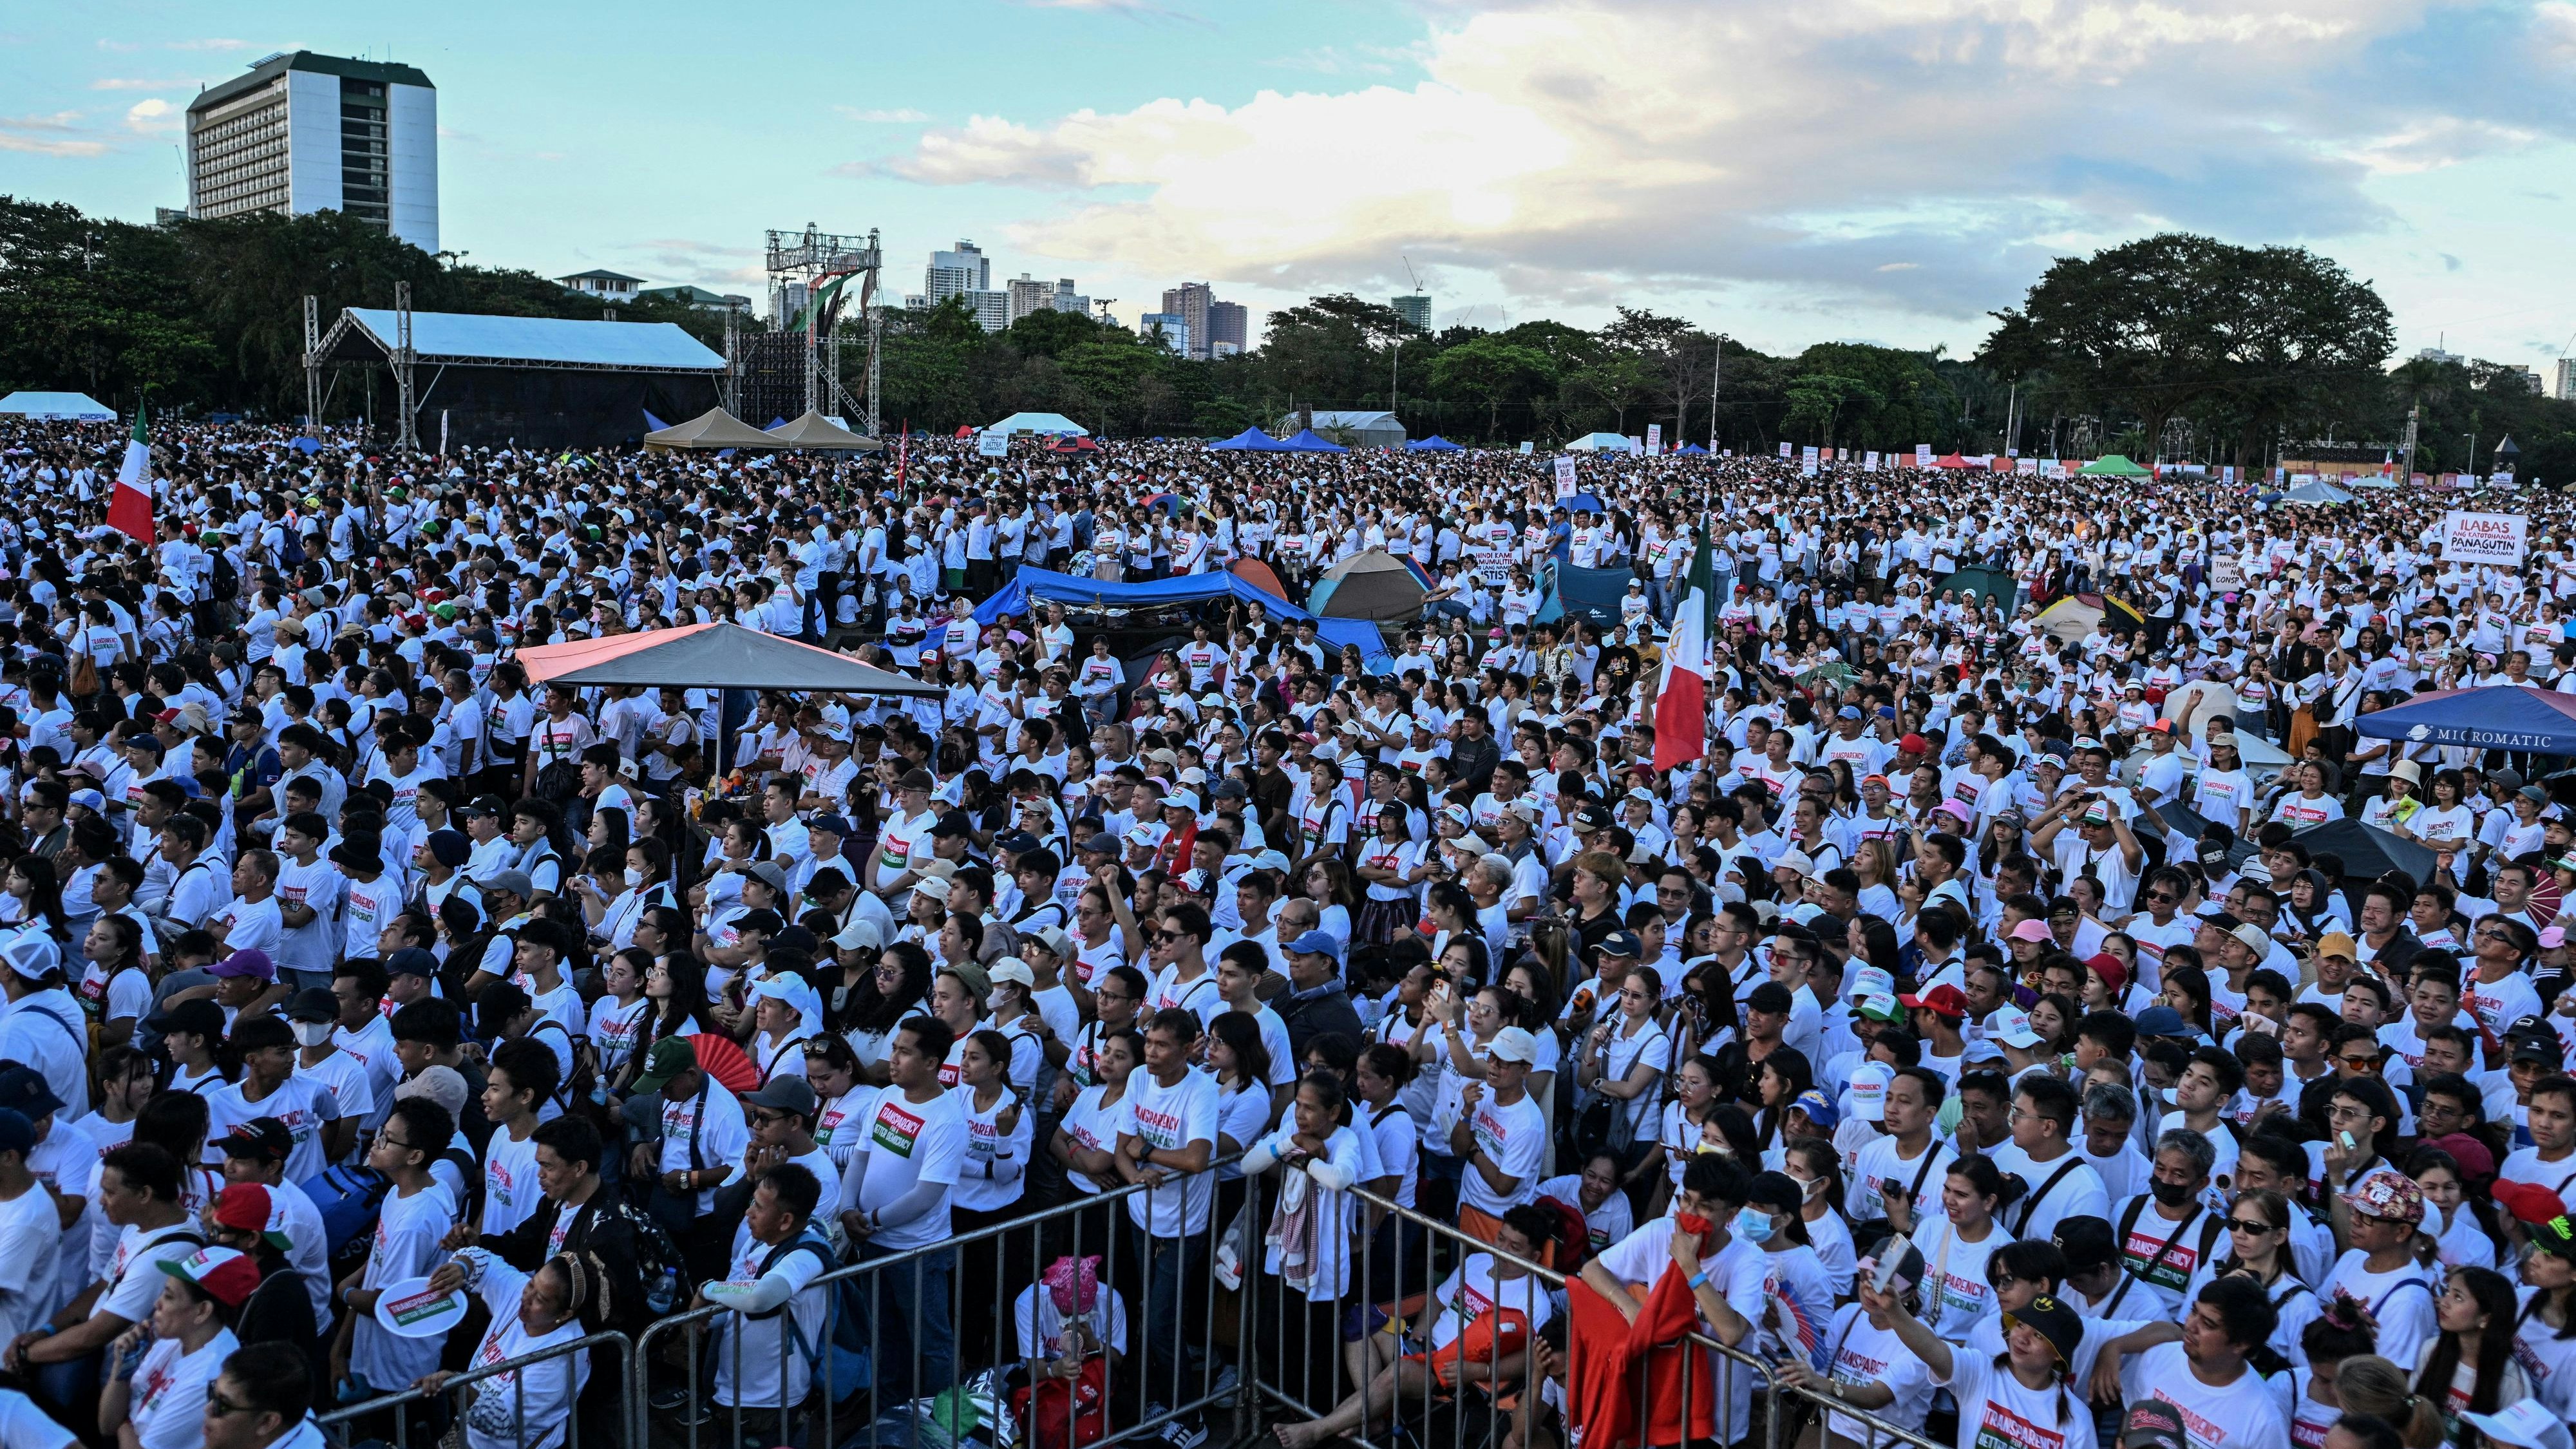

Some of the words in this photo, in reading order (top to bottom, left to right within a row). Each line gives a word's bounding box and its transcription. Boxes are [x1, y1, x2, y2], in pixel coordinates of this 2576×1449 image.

[2461, 519, 2510, 533] ILABAS
[2451, 537, 2514, 550] PANAGUTIN
[2468, 532, 2515, 540] KATOTOHANAN
[2438, 728, 2552, 747] MICROMATIC
[1831, 752, 1865, 760] TRANSPARENCY
[394, 788, 417, 798] PARENCY
[879, 1106, 920, 1134] TRANSPARENCY
[886, 1129, 911, 1150] DEMOCRACY
[2369, 1191, 2390, 1205] UP
[2533, 1238, 2552, 1255] DALLAS
[392, 1292, 440, 1314] TRANSPARENC
[1985, 1407, 2061, 1449] TRANSPARENCY
